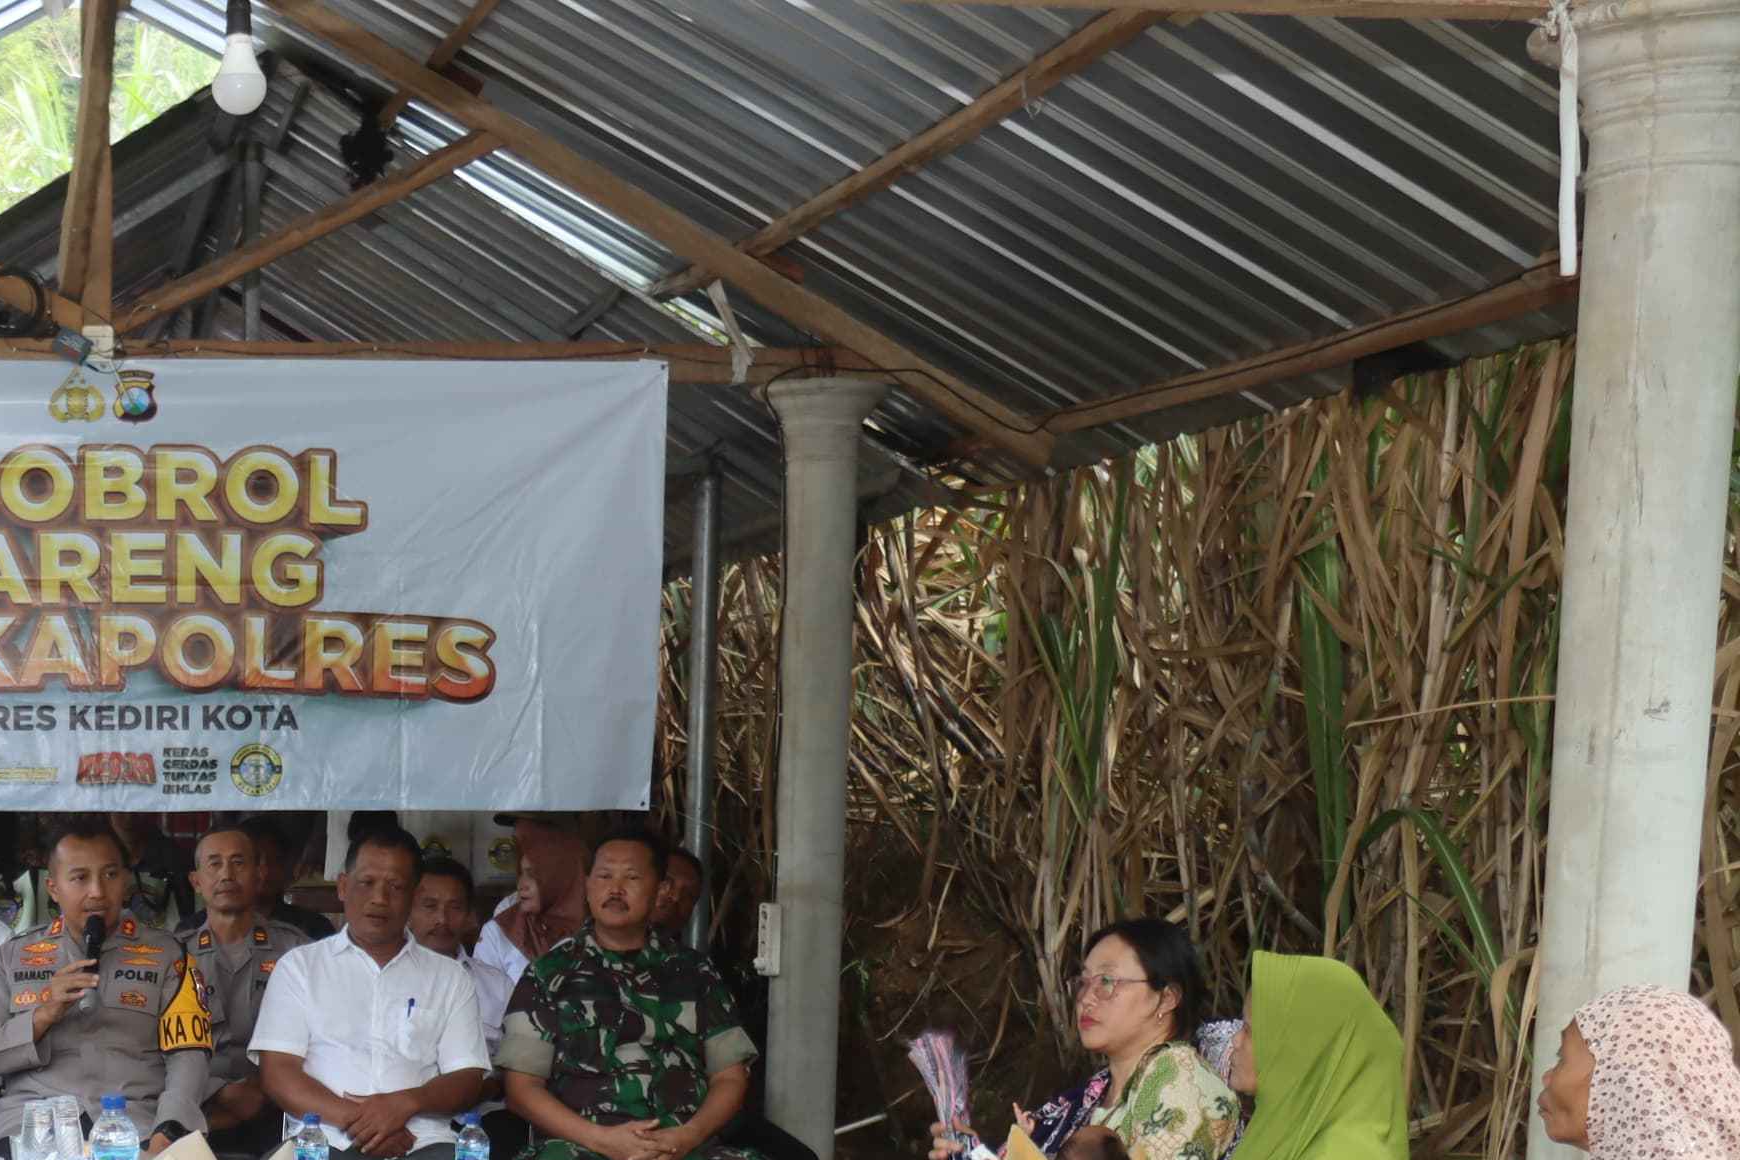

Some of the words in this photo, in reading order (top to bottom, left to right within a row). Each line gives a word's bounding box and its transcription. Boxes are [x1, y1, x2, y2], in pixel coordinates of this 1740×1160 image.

[68, 704, 190, 731] KEDIRI
[201, 704, 300, 731] KOTA
[162, 747, 210, 758] KERAS
[162, 759, 219, 770] CERDAS
[162, 771, 218, 782] TUNTAS
[114, 969, 158, 984] POLRI
[162, 1015, 188, 1047] KA
